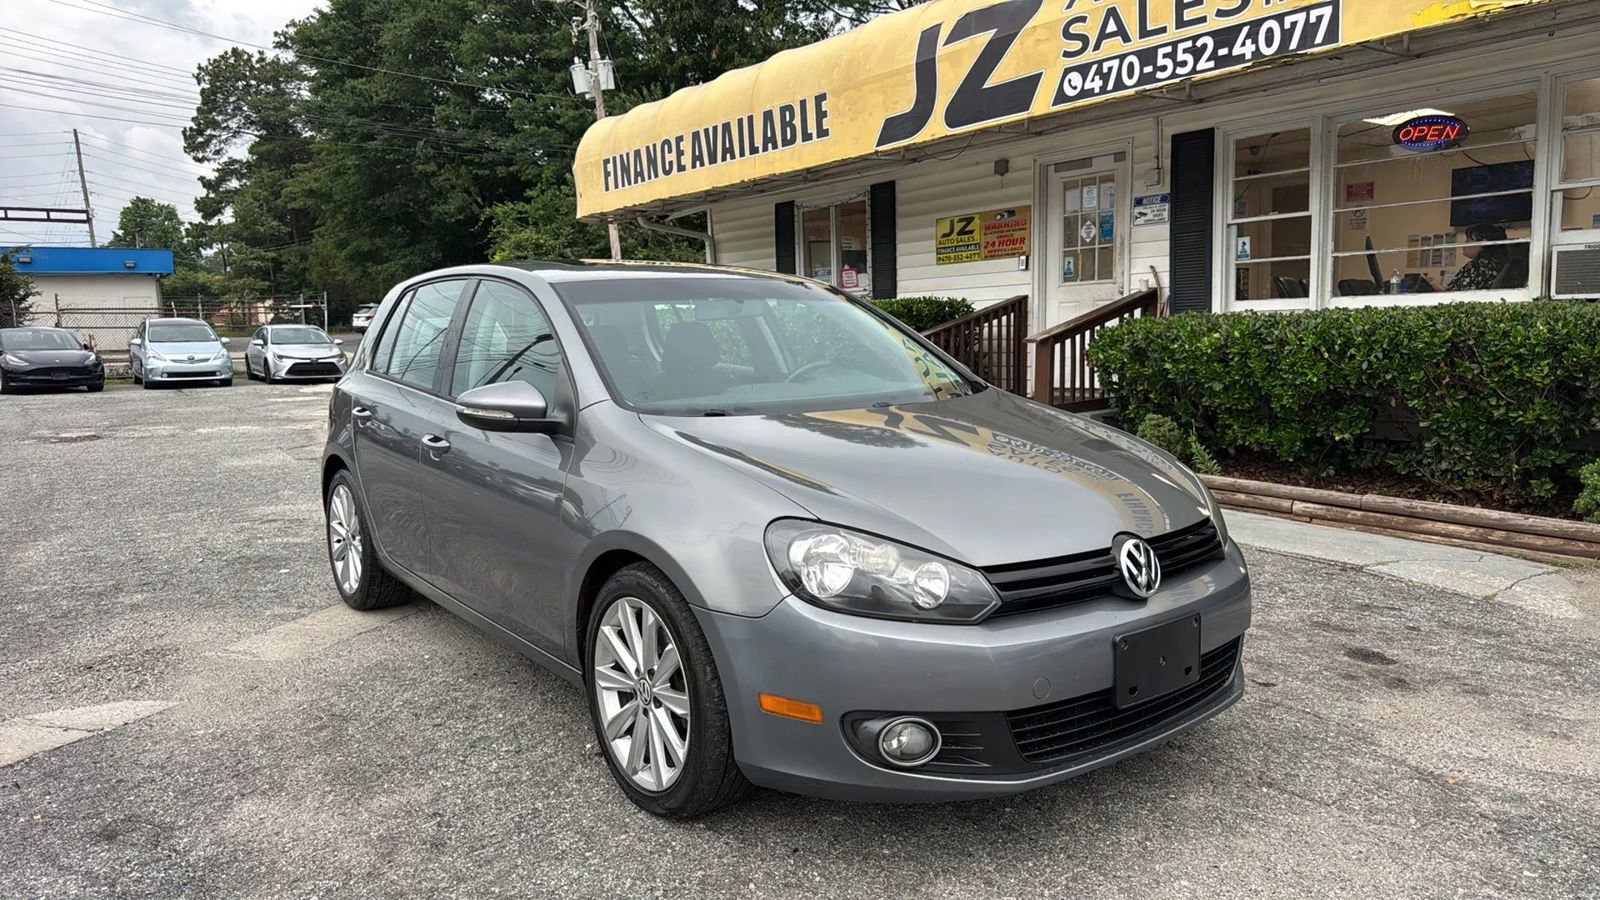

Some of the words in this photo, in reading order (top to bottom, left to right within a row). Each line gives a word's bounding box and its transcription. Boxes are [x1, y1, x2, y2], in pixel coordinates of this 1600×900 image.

[1083, 5, 1333, 94] 470-552-4077
[874, 0, 1045, 149] JZ
[602, 134, 687, 192] FINANCE
[690, 92, 830, 170] AVAILABLE
[1399, 124, 1460, 141] OPEN
[940, 216, 976, 239] JZ
[937, 246, 956, 254] FINANCE
[955, 243, 980, 252] AVAILABLE
[938, 238, 956, 246] AUTO
[955, 235, 976, 245] SALES
[983, 240, 997, 250] 24
[997, 236, 1026, 248] HOUR
